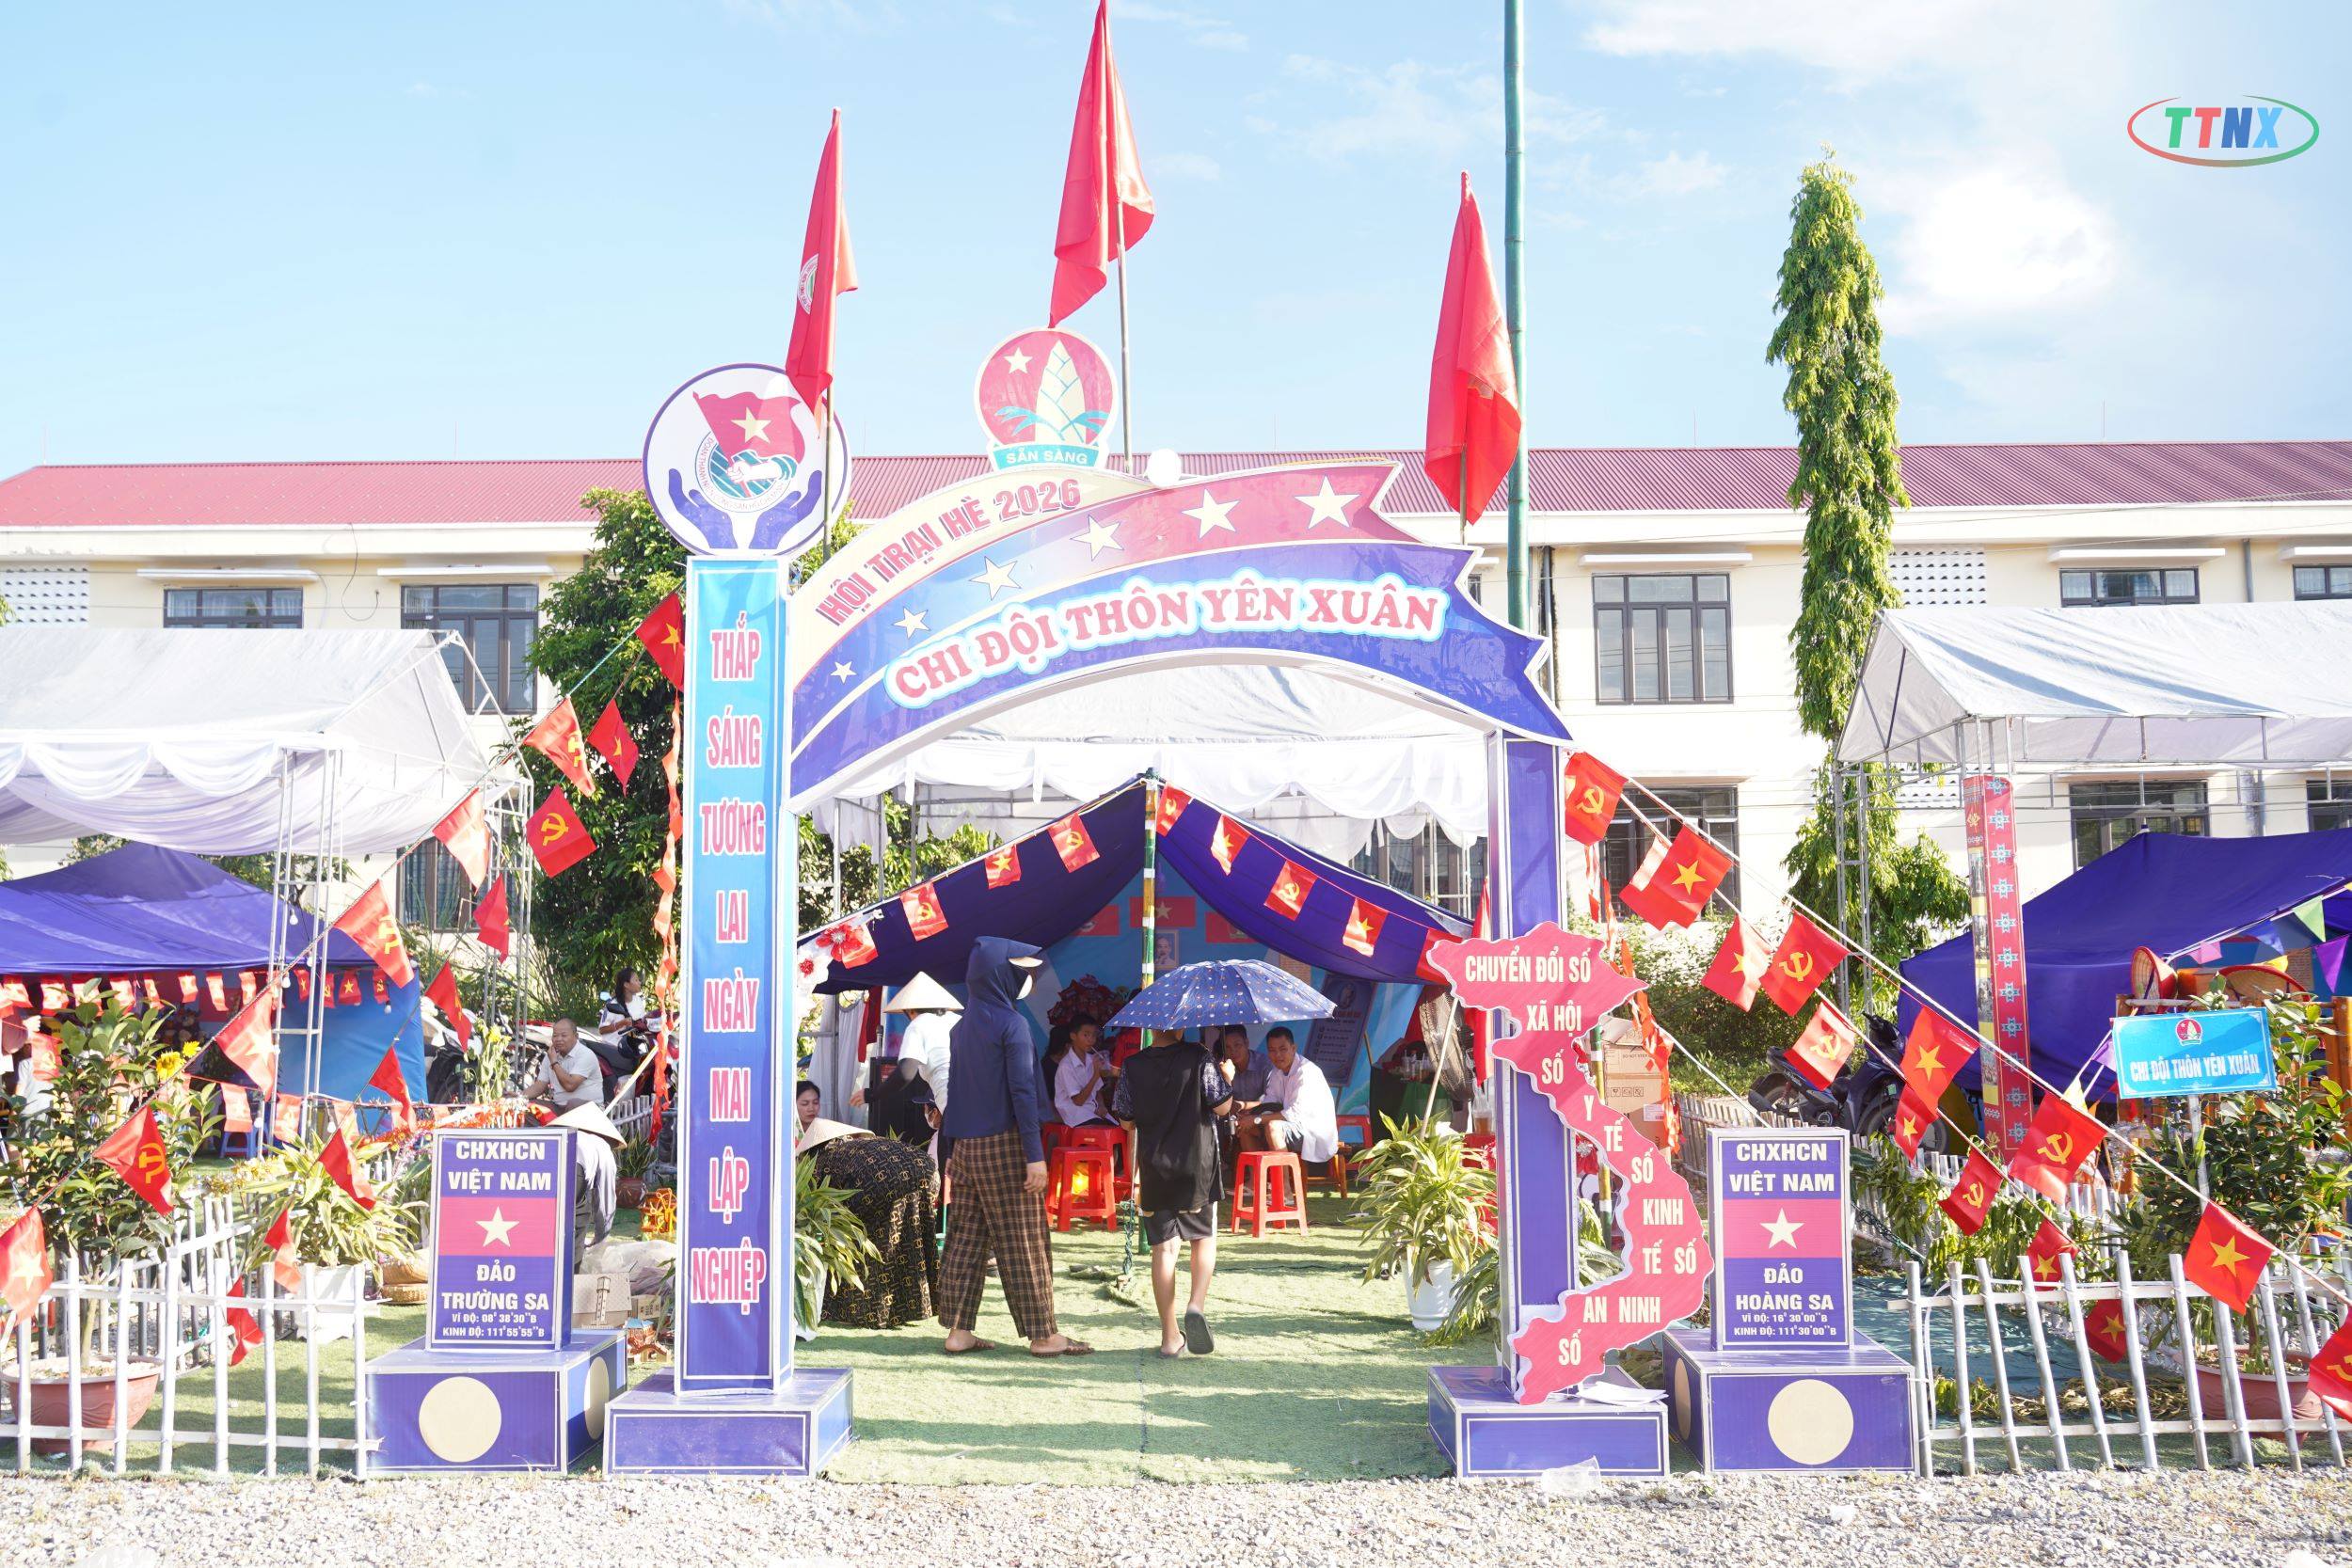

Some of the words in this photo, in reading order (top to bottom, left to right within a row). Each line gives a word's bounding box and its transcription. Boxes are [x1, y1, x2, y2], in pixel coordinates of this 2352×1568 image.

[1043, 449, 1088, 464] SÀNG
[816, 572, 877, 626] HỘI
[864, 522, 943, 583] TRẠI
[938, 496, 991, 542] HÈ
[993, 478, 1081, 522] 2026
[710, 612, 760, 679] THẮP
[896, 643, 972, 698] CHI
[975, 611, 1058, 668] ĐỘI
[1066, 585, 1188, 641] THÔN
[1200, 578, 1295, 624] YÊN
[1305, 583, 1438, 632] XUÂN
[707, 707, 760, 767] SÁNG
[701, 800, 765, 853] TƯƠNG
[716, 891, 748, 942] LAI
[1466, 946, 1531, 983] CHUYỂN
[1535, 946, 1565, 983] ĐỔI
[1568, 947, 1591, 981] SỐ
[704, 969, 758, 1031] NGÀY
[1526, 1004, 1549, 1031] XÃ
[1554, 1001, 1581, 1037] HỘI
[1541, 1049, 1565, 1085] SỐ
[2130, 1061, 2149, 1082] CHI
[2151, 1055, 2169, 1085] ĐỘI
[2171, 1053, 2201, 1079] THÔN
[2203, 1053, 2226, 1077] YÊN
[2228, 1051, 2260, 1075] XUÂN
[710, 1069, 750, 1120] MAI
[1583, 1095, 1595, 1121] Y
[456, 1141, 546, 1160] CHXHCN
[1604, 1117, 1624, 1151] TẾ
[1630, 1147, 1653, 1183] SỐ
[1736, 1143, 1827, 1162] CHXHCN
[448, 1168, 494, 1194] VIỆT
[501, 1172, 551, 1191] NAM
[710, 1147, 748, 1222] LẬP
[1729, 1169, 1776, 1196] VIỆT
[1783, 1173, 1835, 1192] NAM
[1643, 1198, 1683, 1226] KINH
[476, 1259, 516, 1282] ĐẢO
[1643, 1241, 1662, 1275] TẾ
[1674, 1238, 1696, 1274] SỐ
[1764, 1262, 1804, 1284] ĐẢO
[691, 1238, 765, 1314] NGHIỆP
[442, 1289, 518, 1310] TRƯỜNG
[525, 1292, 549, 1310] SA
[1583, 1296, 1607, 1323] AN
[1618, 1296, 1660, 1323] NINH
[1736, 1290, 1803, 1310] HOÀNG
[1808, 1294, 1835, 1310] SA
[442, 1327, 466, 1337] KINH
[1558, 1329, 1581, 1366] SỐ
